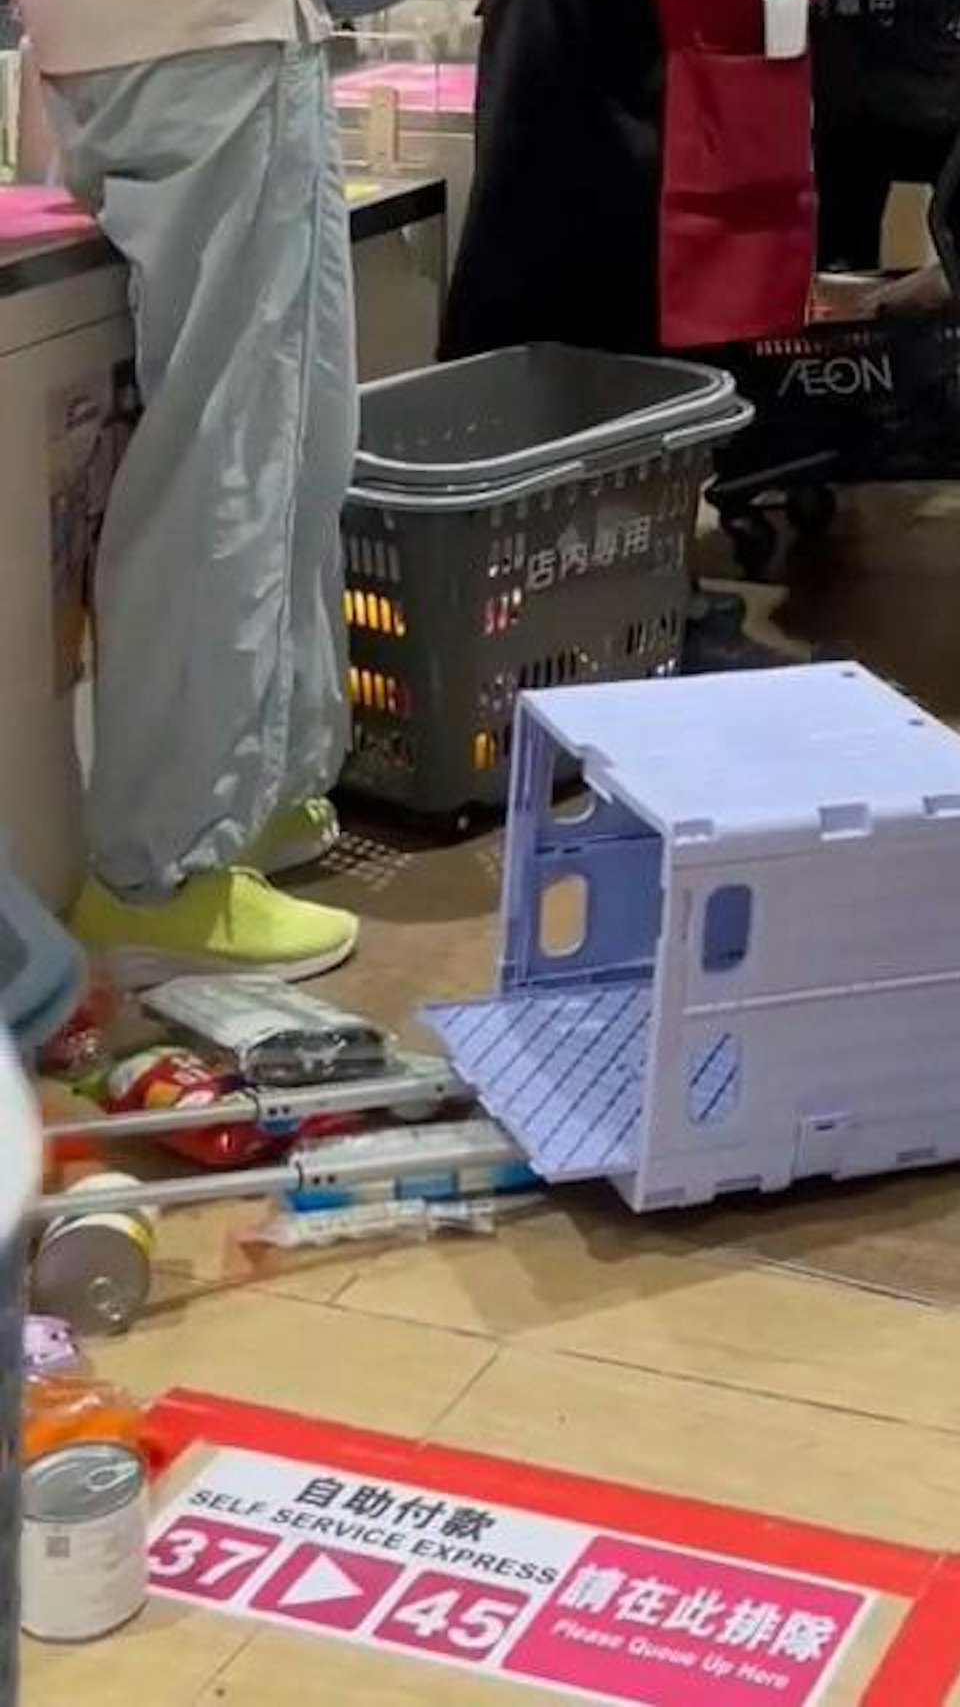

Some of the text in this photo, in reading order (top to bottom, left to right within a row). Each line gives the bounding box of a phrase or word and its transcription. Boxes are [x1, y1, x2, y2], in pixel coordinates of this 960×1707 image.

[188, 1489, 558, 1586] SELF SERVICE EXPRESS
[295, 1476, 496, 1543] 自助付款
[148, 1528, 521, 1649] 37 45
[556, 1563, 837, 1662] 請在此排隊
[552, 1619, 790, 1689] Please Queue Up Here
